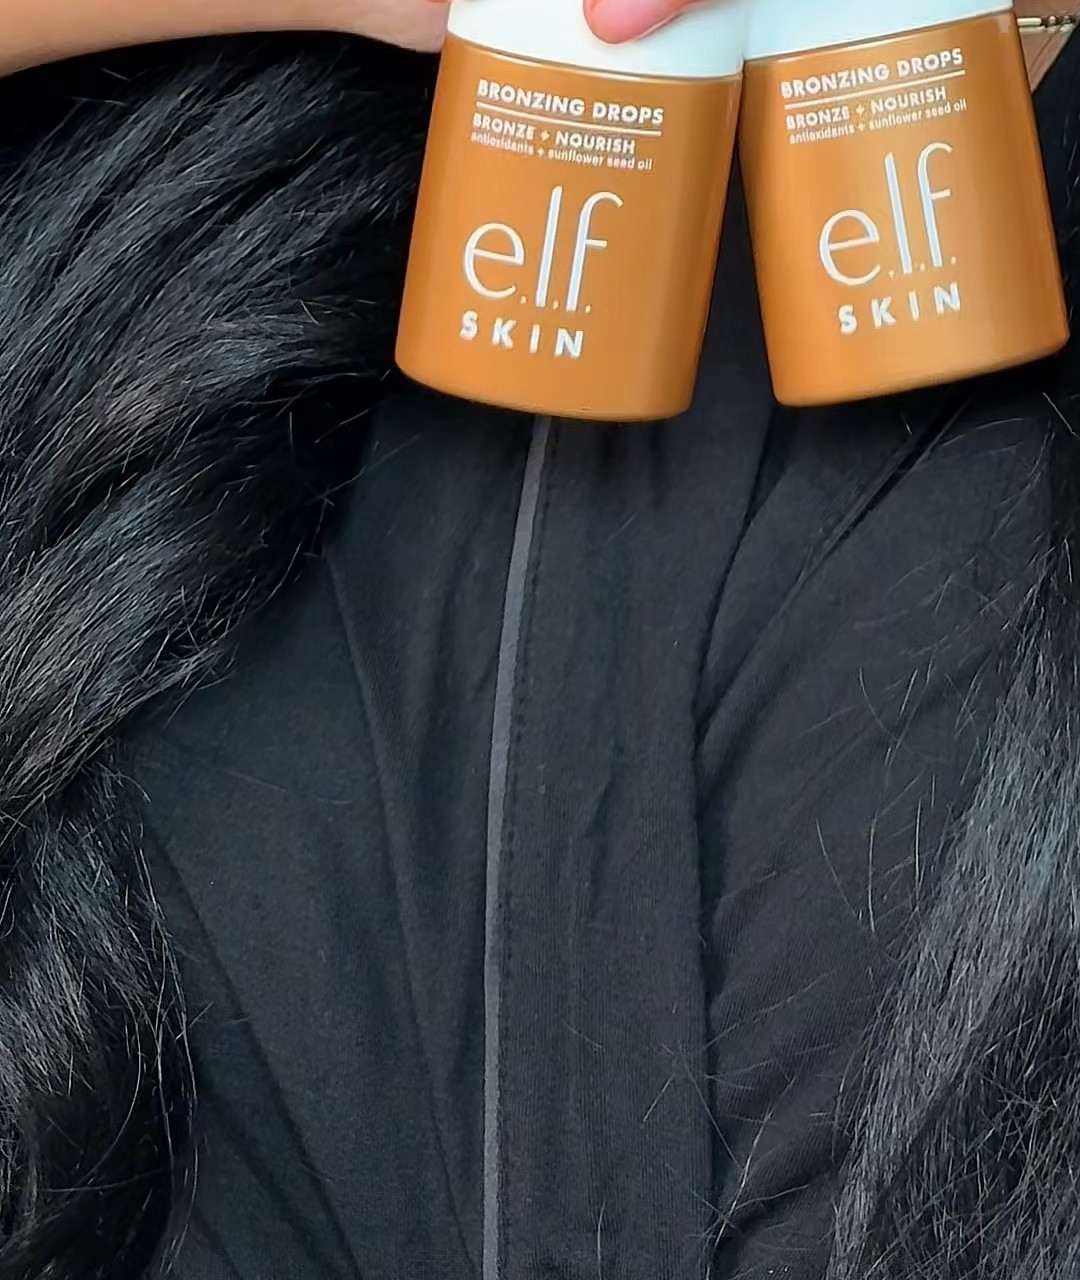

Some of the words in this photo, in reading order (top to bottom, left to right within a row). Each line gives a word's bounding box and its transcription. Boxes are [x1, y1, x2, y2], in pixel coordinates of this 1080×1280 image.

[780, 63, 889, 99] BRONZING
[897, 48, 963, 77] DROPS
[477, 79, 585, 116] BRONZING
[592, 102, 665, 125] DROPS
[786, 106, 850, 130] BRONZE
[856, 104, 865, 116] +
[871, 86, 947, 115] NOURISH
[789, 122, 855, 145] antioxidants
[858, 122, 866, 132] +
[869, 110, 922, 130] sunflower
[925, 102, 952, 118] seed
[953, 97, 967, 112] oil
[471, 132, 534, 156] antioxidants
[537, 147, 545, 157] +
[548, 148, 604, 167] sunflower
[607, 156, 635, 170] seed
[637, 158, 653, 171] oil
[473, 112, 536, 141] BRONZE
[540, 130, 550, 141] +
[555, 130, 636, 154] NOURISH
[838, 282, 961, 335] SKIN
[459, 310, 584, 359] SKIN
